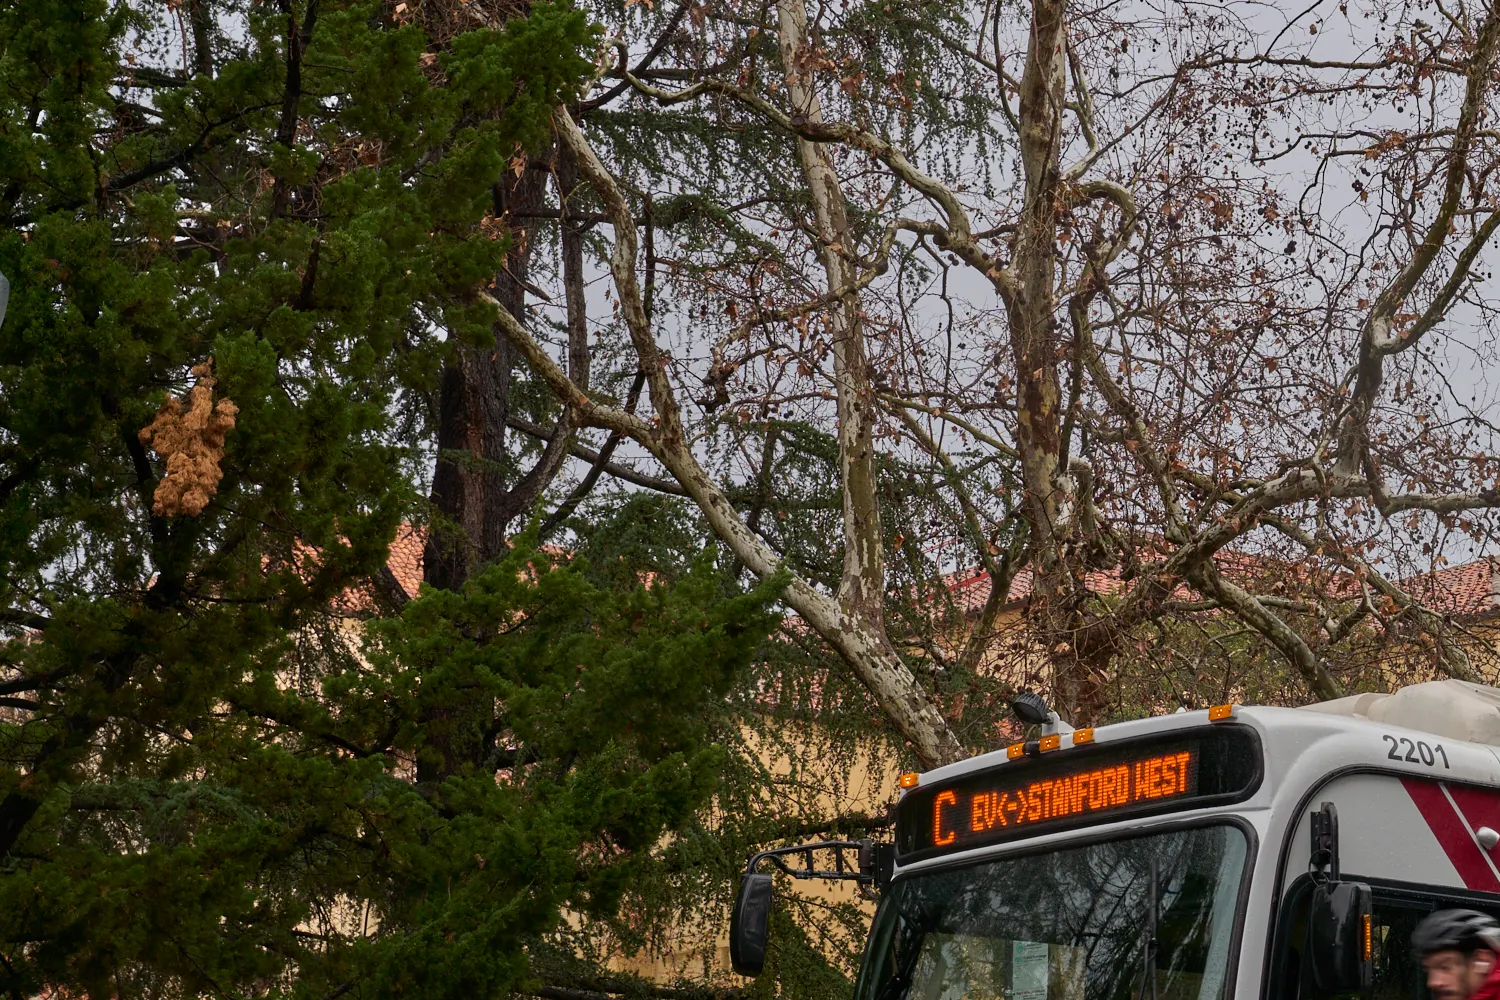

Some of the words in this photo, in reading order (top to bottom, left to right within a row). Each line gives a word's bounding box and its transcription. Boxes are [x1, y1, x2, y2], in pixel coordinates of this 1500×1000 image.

[1382, 734, 1451, 769] 2201
[933, 789, 956, 846] C
[1135, 751, 1190, 800] WEST
